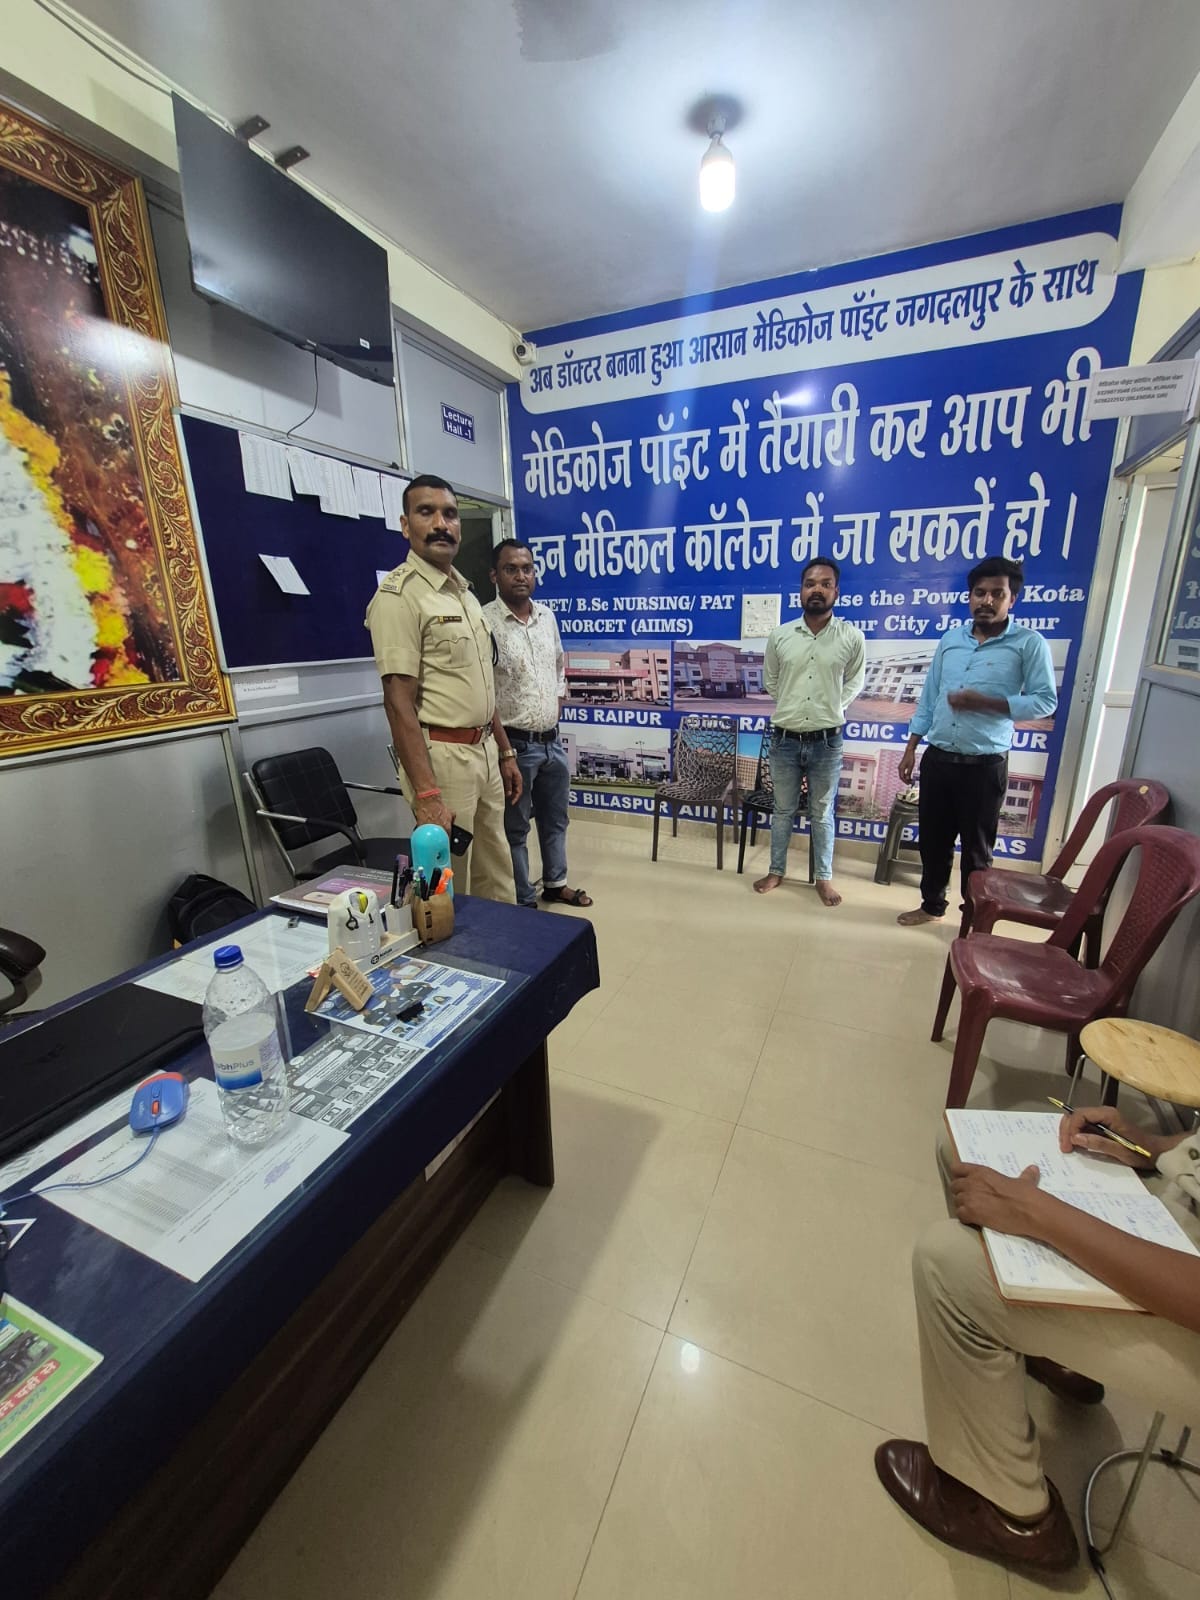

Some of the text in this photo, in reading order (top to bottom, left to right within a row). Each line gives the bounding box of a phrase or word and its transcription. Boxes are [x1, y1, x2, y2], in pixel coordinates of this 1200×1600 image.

[530, 259, 1099, 393] अब डॉक्टर बनना हुआ आसान मेडिकोज पॉइंट जगदलपुर के साथ
[442, 406, 473, 428] Lecture
[522, 346, 1102, 499] मेडिकोज पॉइंट में तैयारी कर आप भी
[446, 420, 463, 436] Hall
[529, 534, 568, 586] इन
[572, 509, 677, 579] मेडिकल
[683, 497, 783, 570] कॉलेज
[791, 490, 825, 563] में
[832, 511, 880, 566] जा
[889, 476, 997, 564] सकतें
[1002, 471, 1051, 562] हो
[576, 597, 609, 612] B.Sc
[612, 594, 696, 612] NURSING/
[700, 594, 735, 610] PAT
[870, 590, 905, 606] the
[911, 588, 971, 605] Powe
[1021, 584, 1085, 603] Kota
[561, 618, 694, 636] NORCET (AIIMS)
[884, 615, 930, 635] City
[593, 709, 662, 726] RAIPUR
[845, 722, 895, 740] GMC
[583, 793, 669, 814] BILASPUR
[838, 819, 888, 838] BHU
